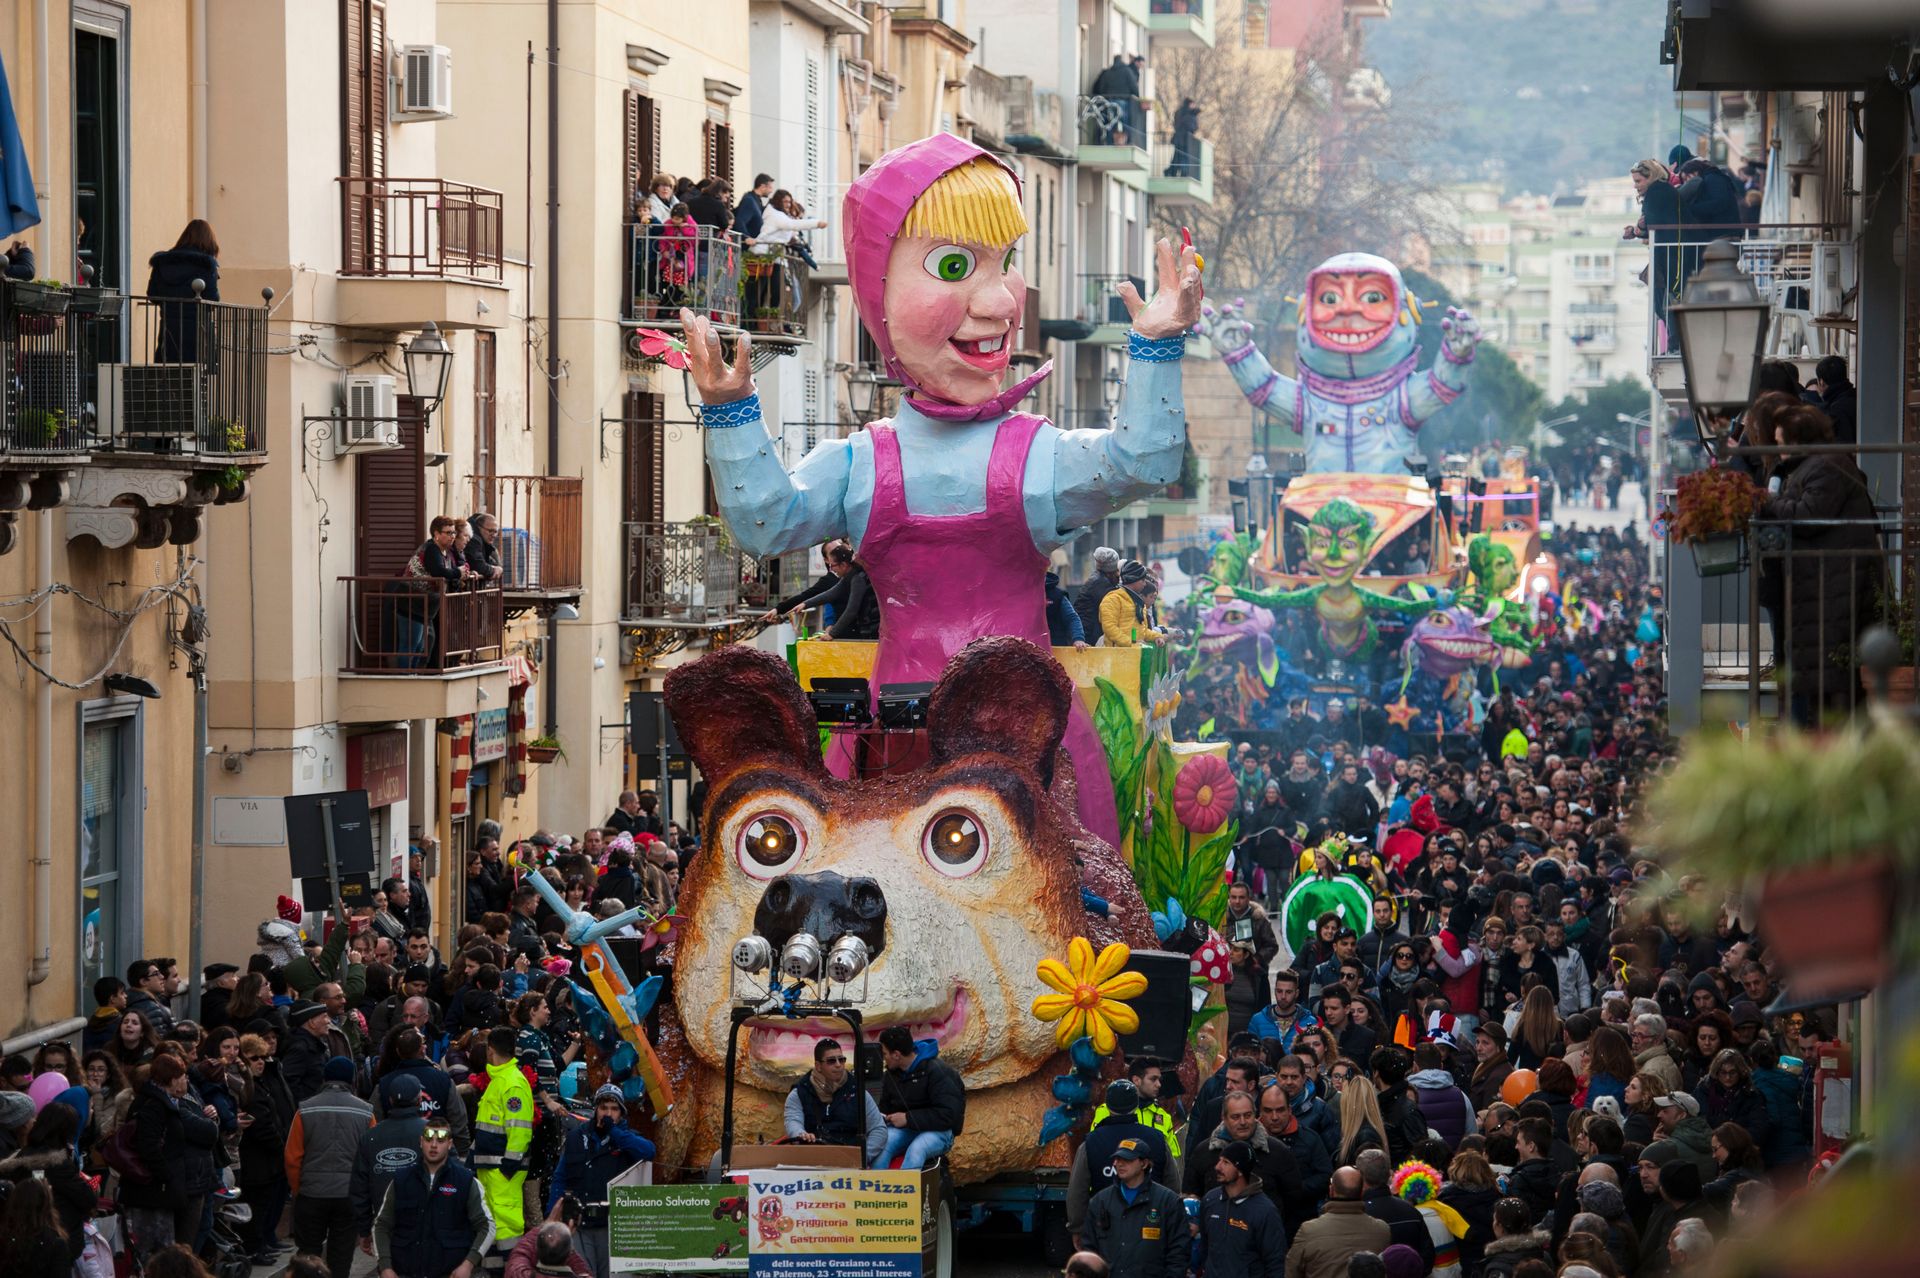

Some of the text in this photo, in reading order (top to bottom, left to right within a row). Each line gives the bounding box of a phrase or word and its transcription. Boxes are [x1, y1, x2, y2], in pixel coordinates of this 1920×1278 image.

[383, 771, 399, 798] Corso
[240, 802, 258, 810] VIA
[753, 1177, 916, 1196] Voglia di Pizza
[616, 1196, 710, 1207] Palmisano Salvatore
[796, 1201, 846, 1210] Pizzeria
[854, 1200, 908, 1210] Panineria
[796, 1219, 848, 1228] Friggitoria
[856, 1218, 914, 1227] Rosticceria
[790, 1235, 854, 1244] Gastronomia
[860, 1234, 917, 1243] Cornetteria
[771, 1259, 794, 1267] delle
[756, 1270, 772, 1278] Via
[773, 1270, 815, 1278] Palermo,
[817, 1270, 830, 1278] 23
[836, 1270, 870, 1278] Termini
[872, 1270, 912, 1278] Imerese
